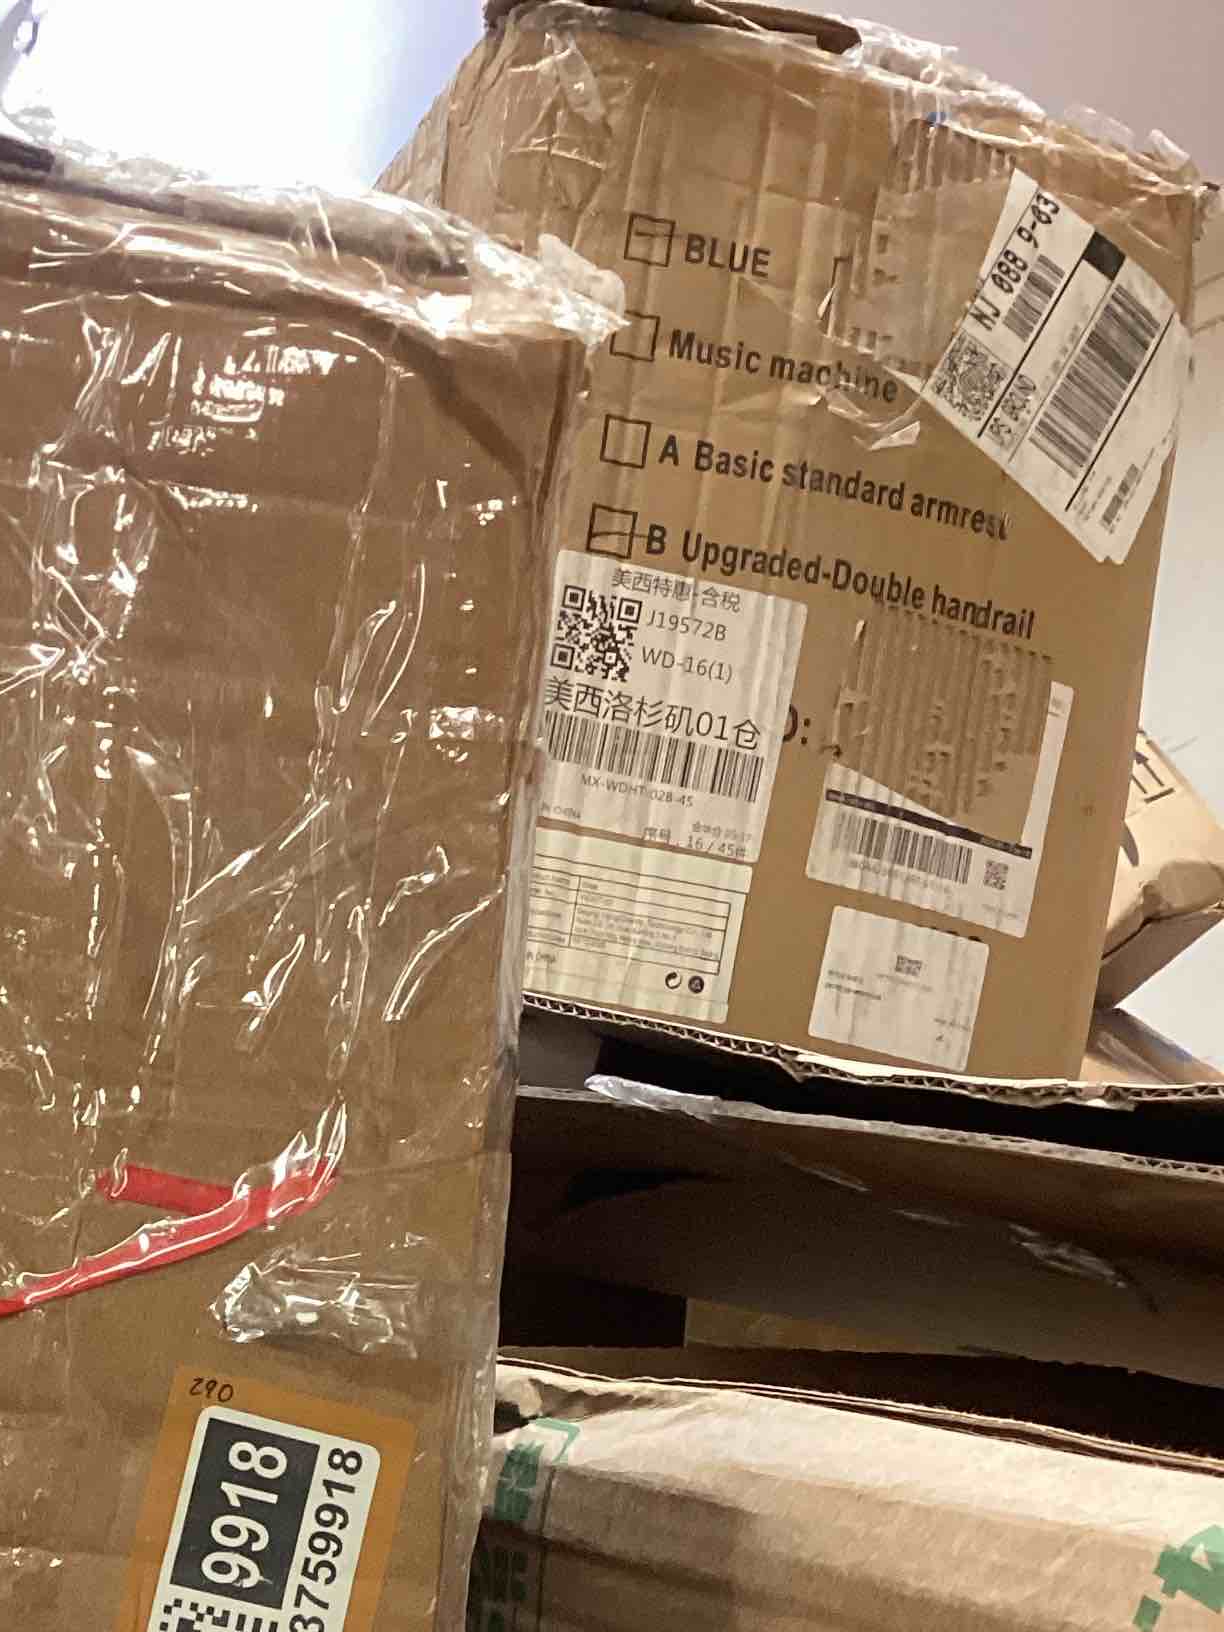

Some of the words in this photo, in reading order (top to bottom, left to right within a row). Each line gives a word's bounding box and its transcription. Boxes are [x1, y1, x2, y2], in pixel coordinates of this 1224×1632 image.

[684, 232, 771, 279] BLUE
[969, 295, 1002, 332] NJ
[668, 328, 762, 376] Music
[768, 348, 899, 404] machine
[658, 434, 681, 468] A
[693, 440, 775, 484] Basic
[781, 457, 906, 512] standard
[910, 492, 1009, 541] armrest
[643, 523, 669, 557] B
[681, 530, 926, 614] Upgraded-Double
[931, 585, 1036, 641] handrail
[645, 607, 727, 643] J19572B
[641, 647, 734, 684] WD-16(1)
[543, 676, 762, 752] 美西洛杉矶01仓
[201, 1440, 288, 1590] 9918
